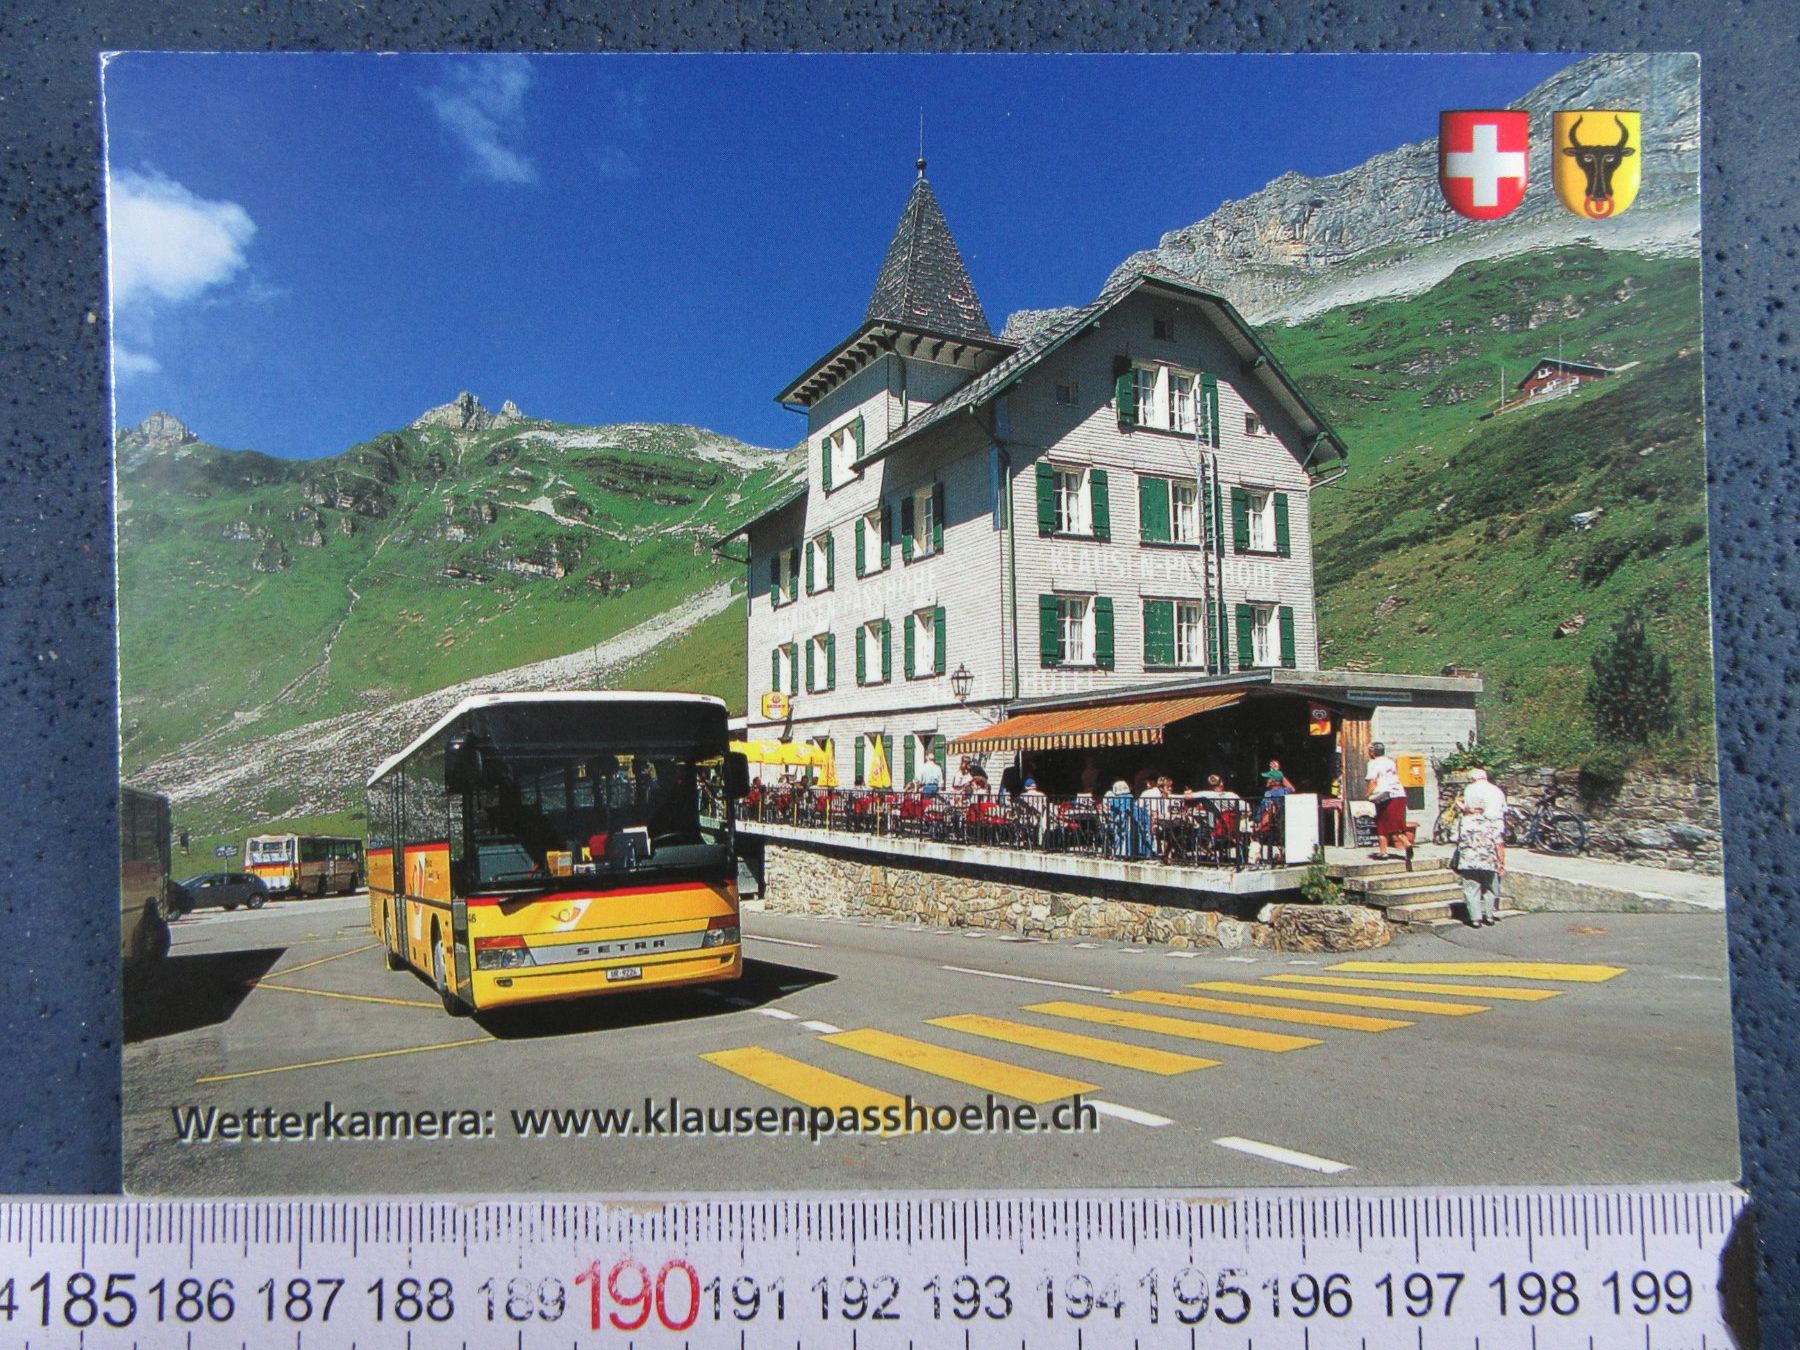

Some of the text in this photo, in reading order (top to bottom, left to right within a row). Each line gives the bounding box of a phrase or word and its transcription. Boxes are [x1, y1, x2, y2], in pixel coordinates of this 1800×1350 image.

[577, 940, 665, 955] SETRA
[172, 1095, 1098, 1141] Wetterkamera: www.klausenpasshoehe.ch
[30, 1271, 137, 1327] 185
[149, 1278, 235, 1323] 186
[258, 1278, 345, 1322] 187
[366, 1277, 455, 1322] 188
[477, 1277, 566, 1322] 189
[574, 1259, 701, 1331] 190
[704, 1276, 787, 1321] 191
[811, 1275, 901, 1321] 192
[922, 1275, 1013, 1320] 193
[1036, 1274, 1125, 1319] 194
[1138, 1268, 1251, 1323] 195
[1261, 1273, 1352, 1318] 196
[1374, 1273, 1466, 1317] 197
[1488, 1271, 1580, 1316] 198
[1602, 1270, 1693, 1315] 199
